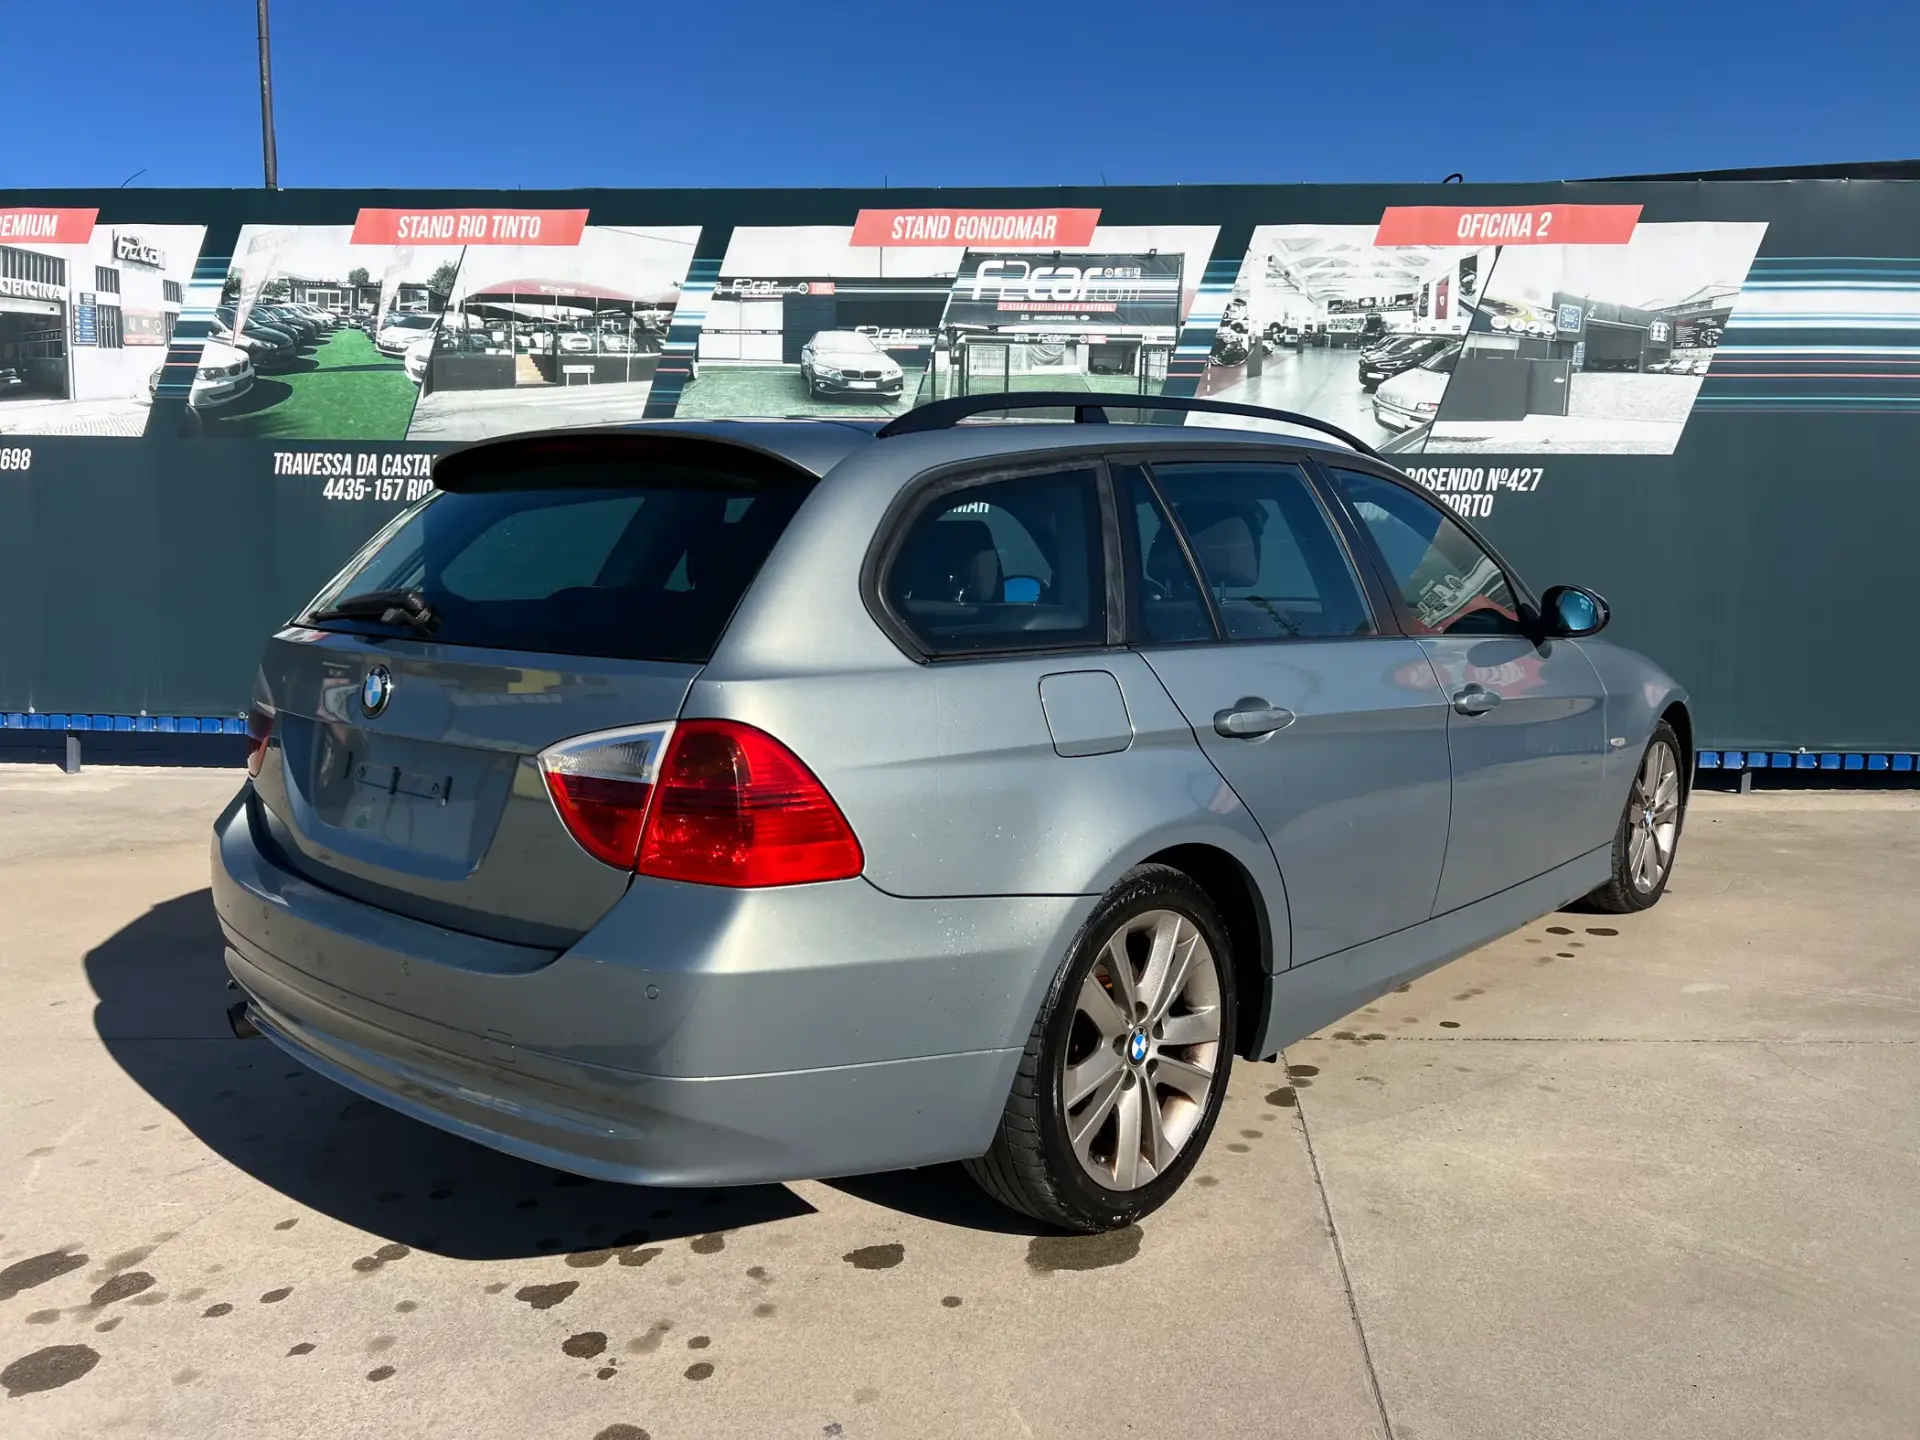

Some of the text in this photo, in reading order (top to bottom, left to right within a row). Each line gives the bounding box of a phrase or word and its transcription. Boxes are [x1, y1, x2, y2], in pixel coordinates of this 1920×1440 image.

[0, 214, 58, 237] EMIUM
[397, 216, 541, 239] STAND RIO TINTO
[891, 215, 1058, 240] STAND GONDOMAR
[1456, 211, 1552, 238] OFICINA 2
[0, 447, 32, 470] 698
[273, 452, 439, 477] TRAVESSA DA CASTA
[322, 478, 404, 501] 4435-157
